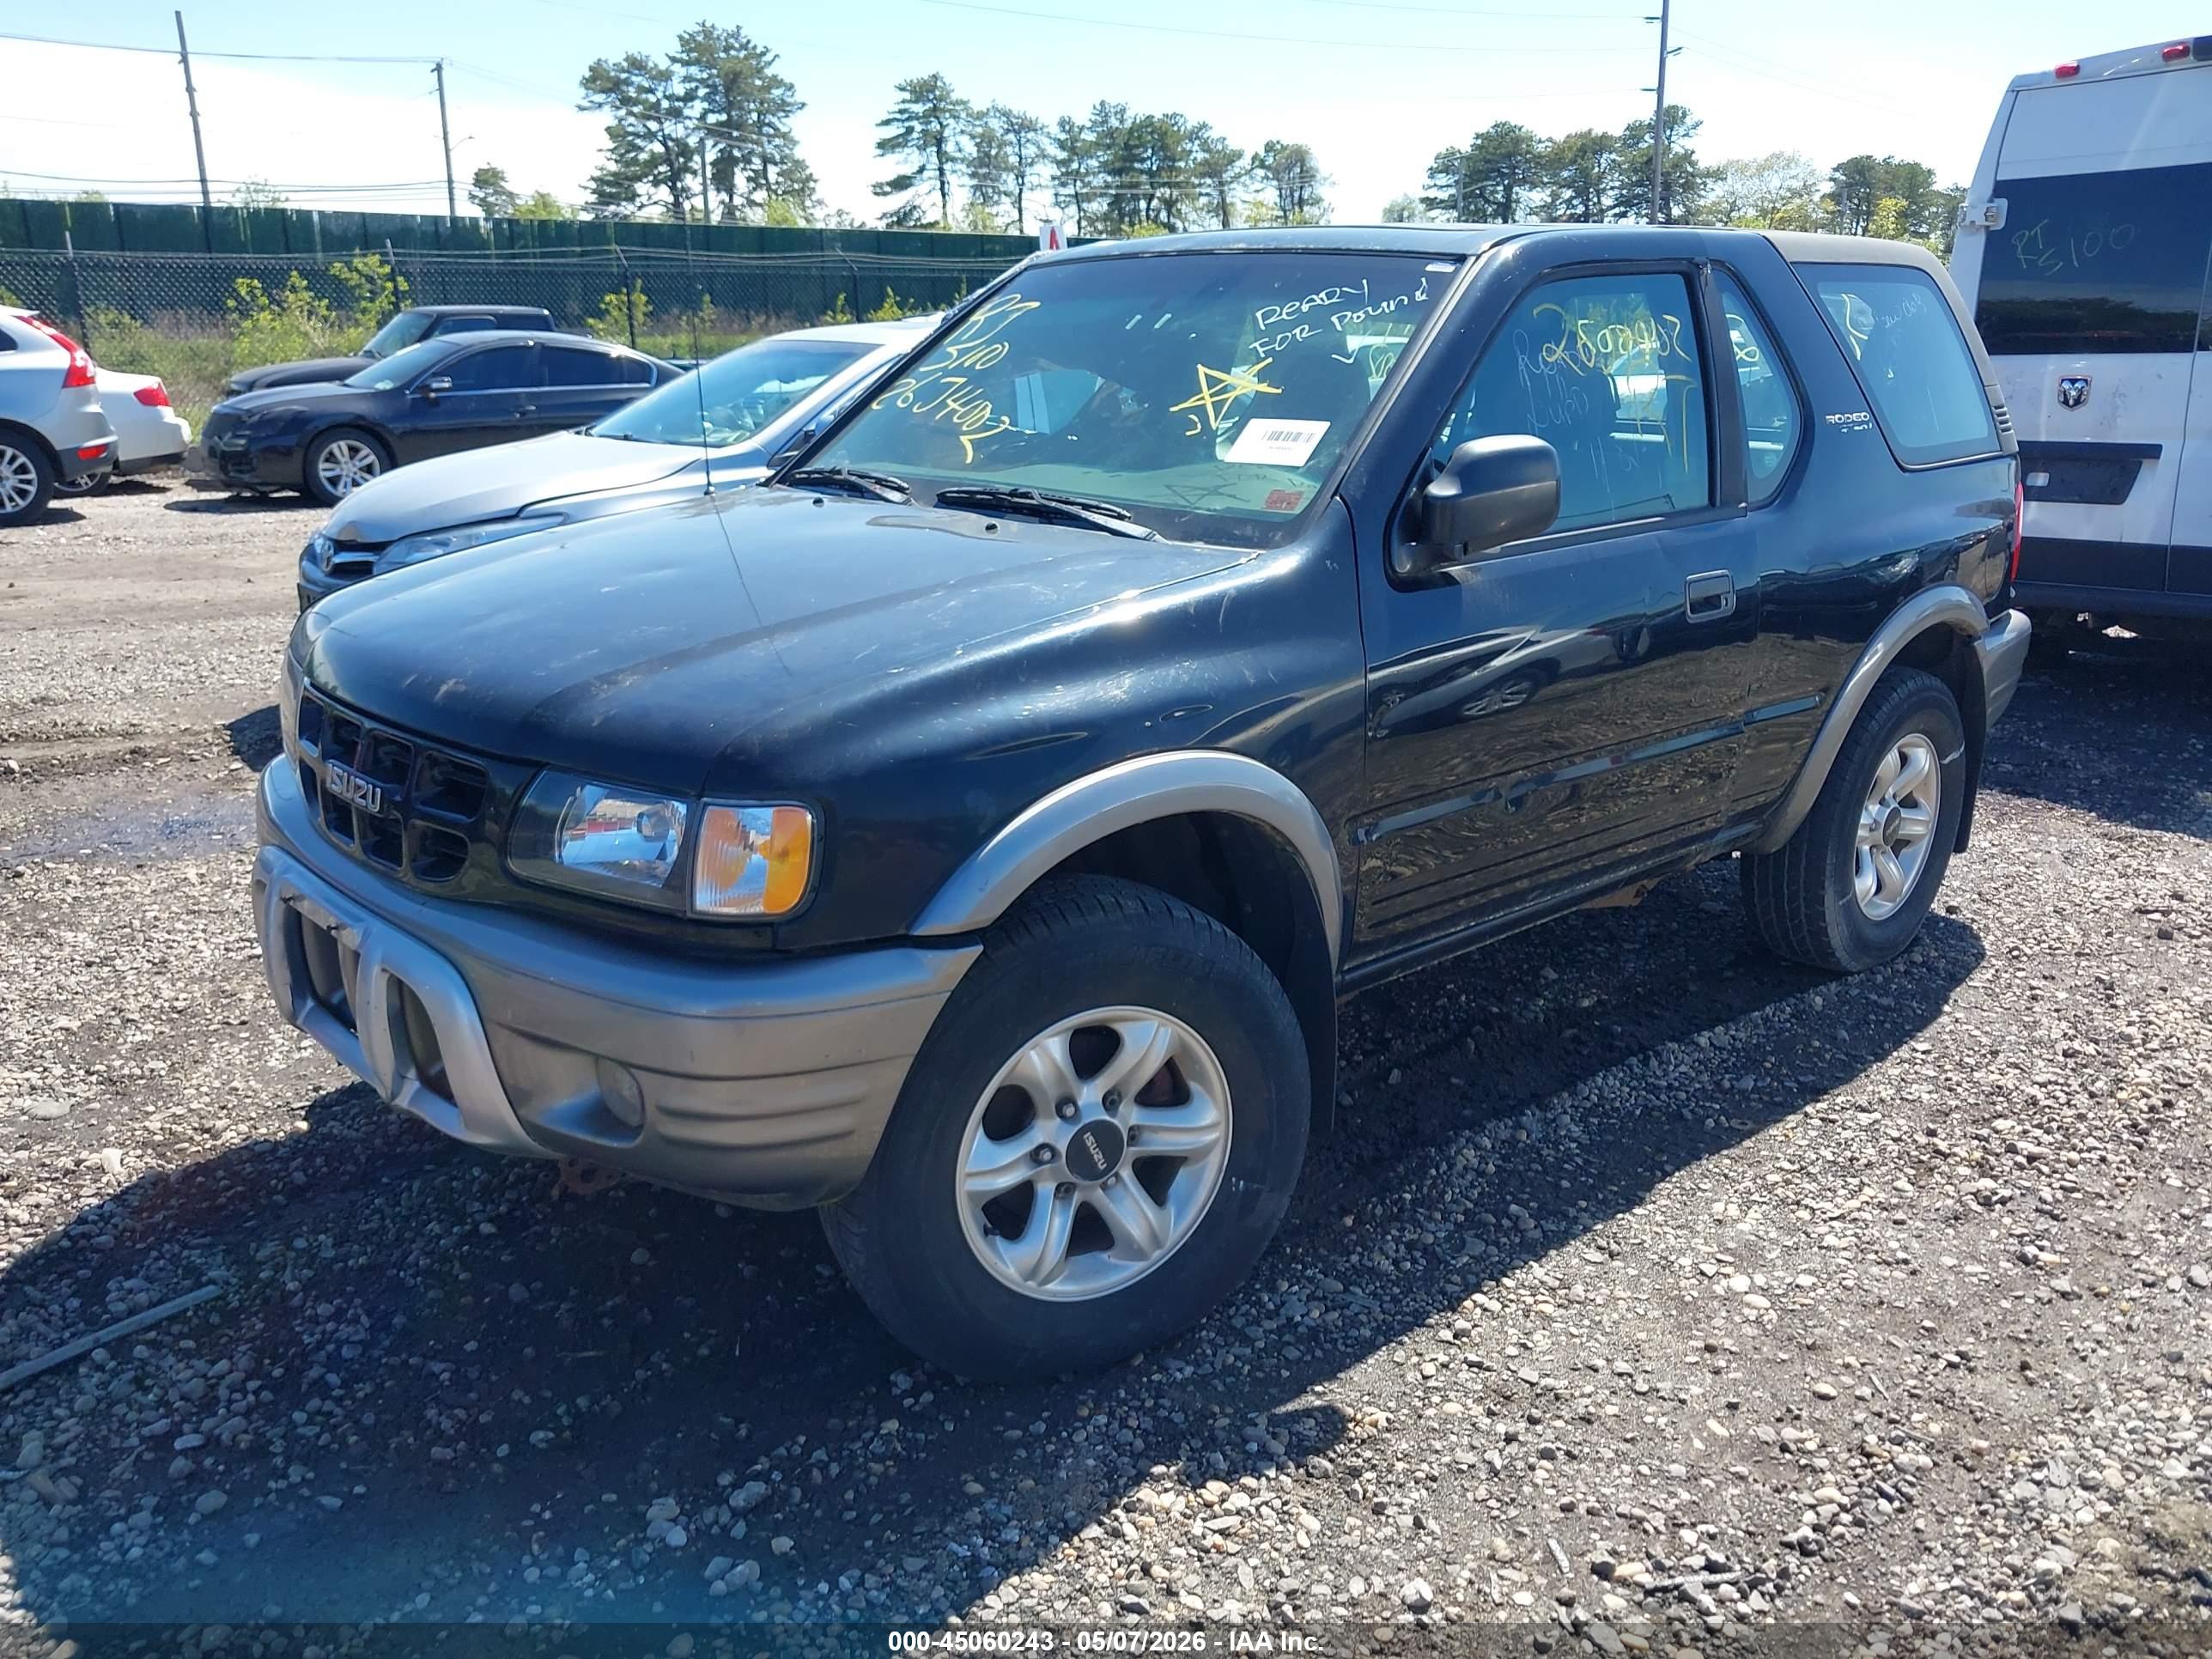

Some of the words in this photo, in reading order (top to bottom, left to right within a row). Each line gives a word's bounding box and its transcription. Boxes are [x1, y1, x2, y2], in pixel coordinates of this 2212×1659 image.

[1249, 323, 1323, 358] FOR
[1825, 411, 1870, 425] RODEO
[327, 763, 382, 812] ISUZU
[1083, 1131, 1108, 1170] ISUZU
